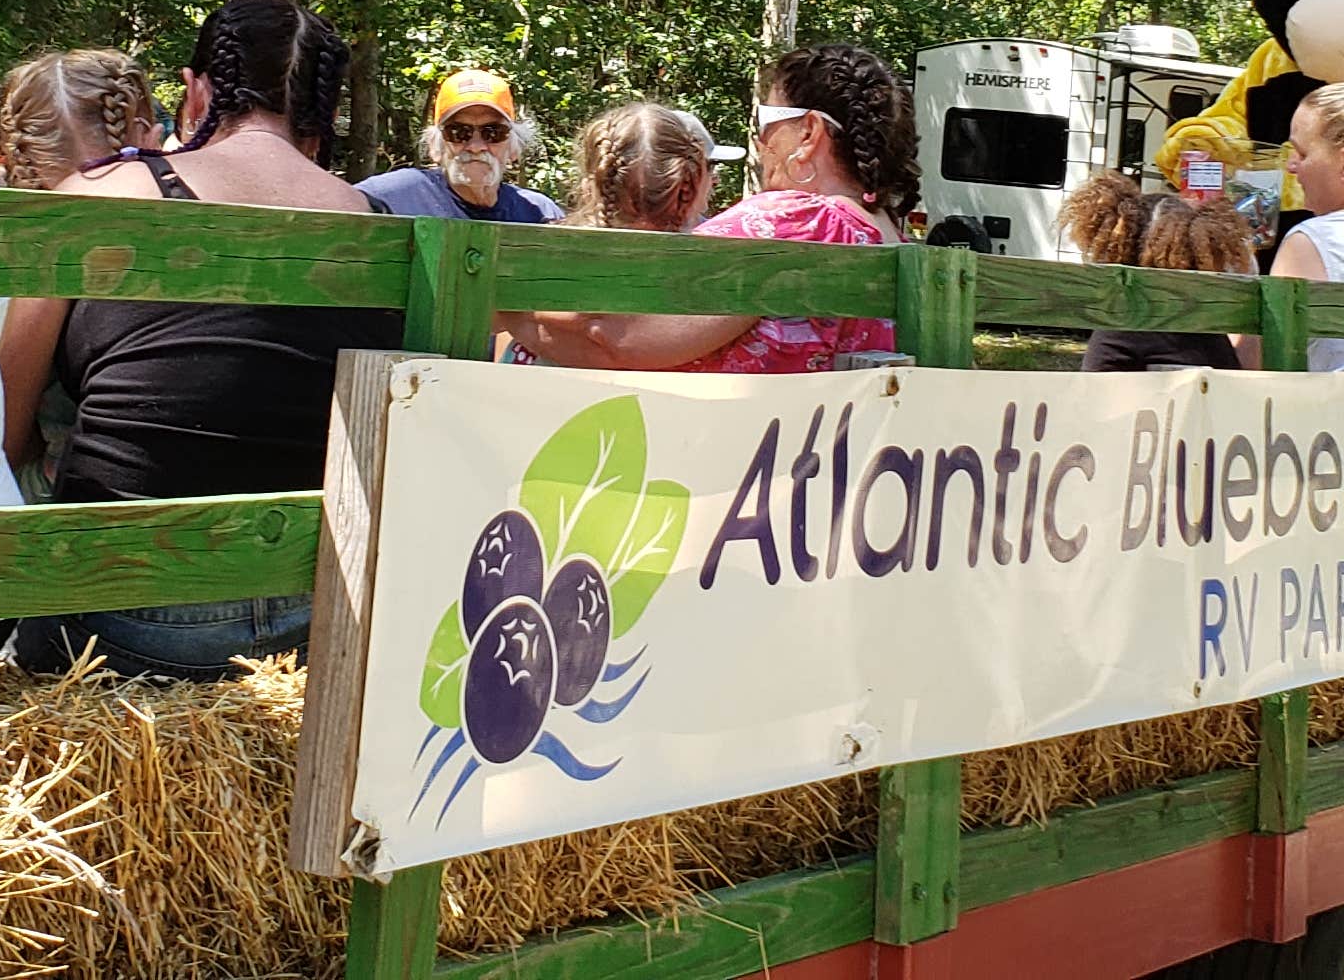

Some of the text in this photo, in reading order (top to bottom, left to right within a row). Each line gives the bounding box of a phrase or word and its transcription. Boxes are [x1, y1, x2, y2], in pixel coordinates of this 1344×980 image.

[964, 72, 1051, 90] HEMISPHERE
[699, 401, 1096, 590] Atlantic
[1199, 572, 1259, 680] RV
